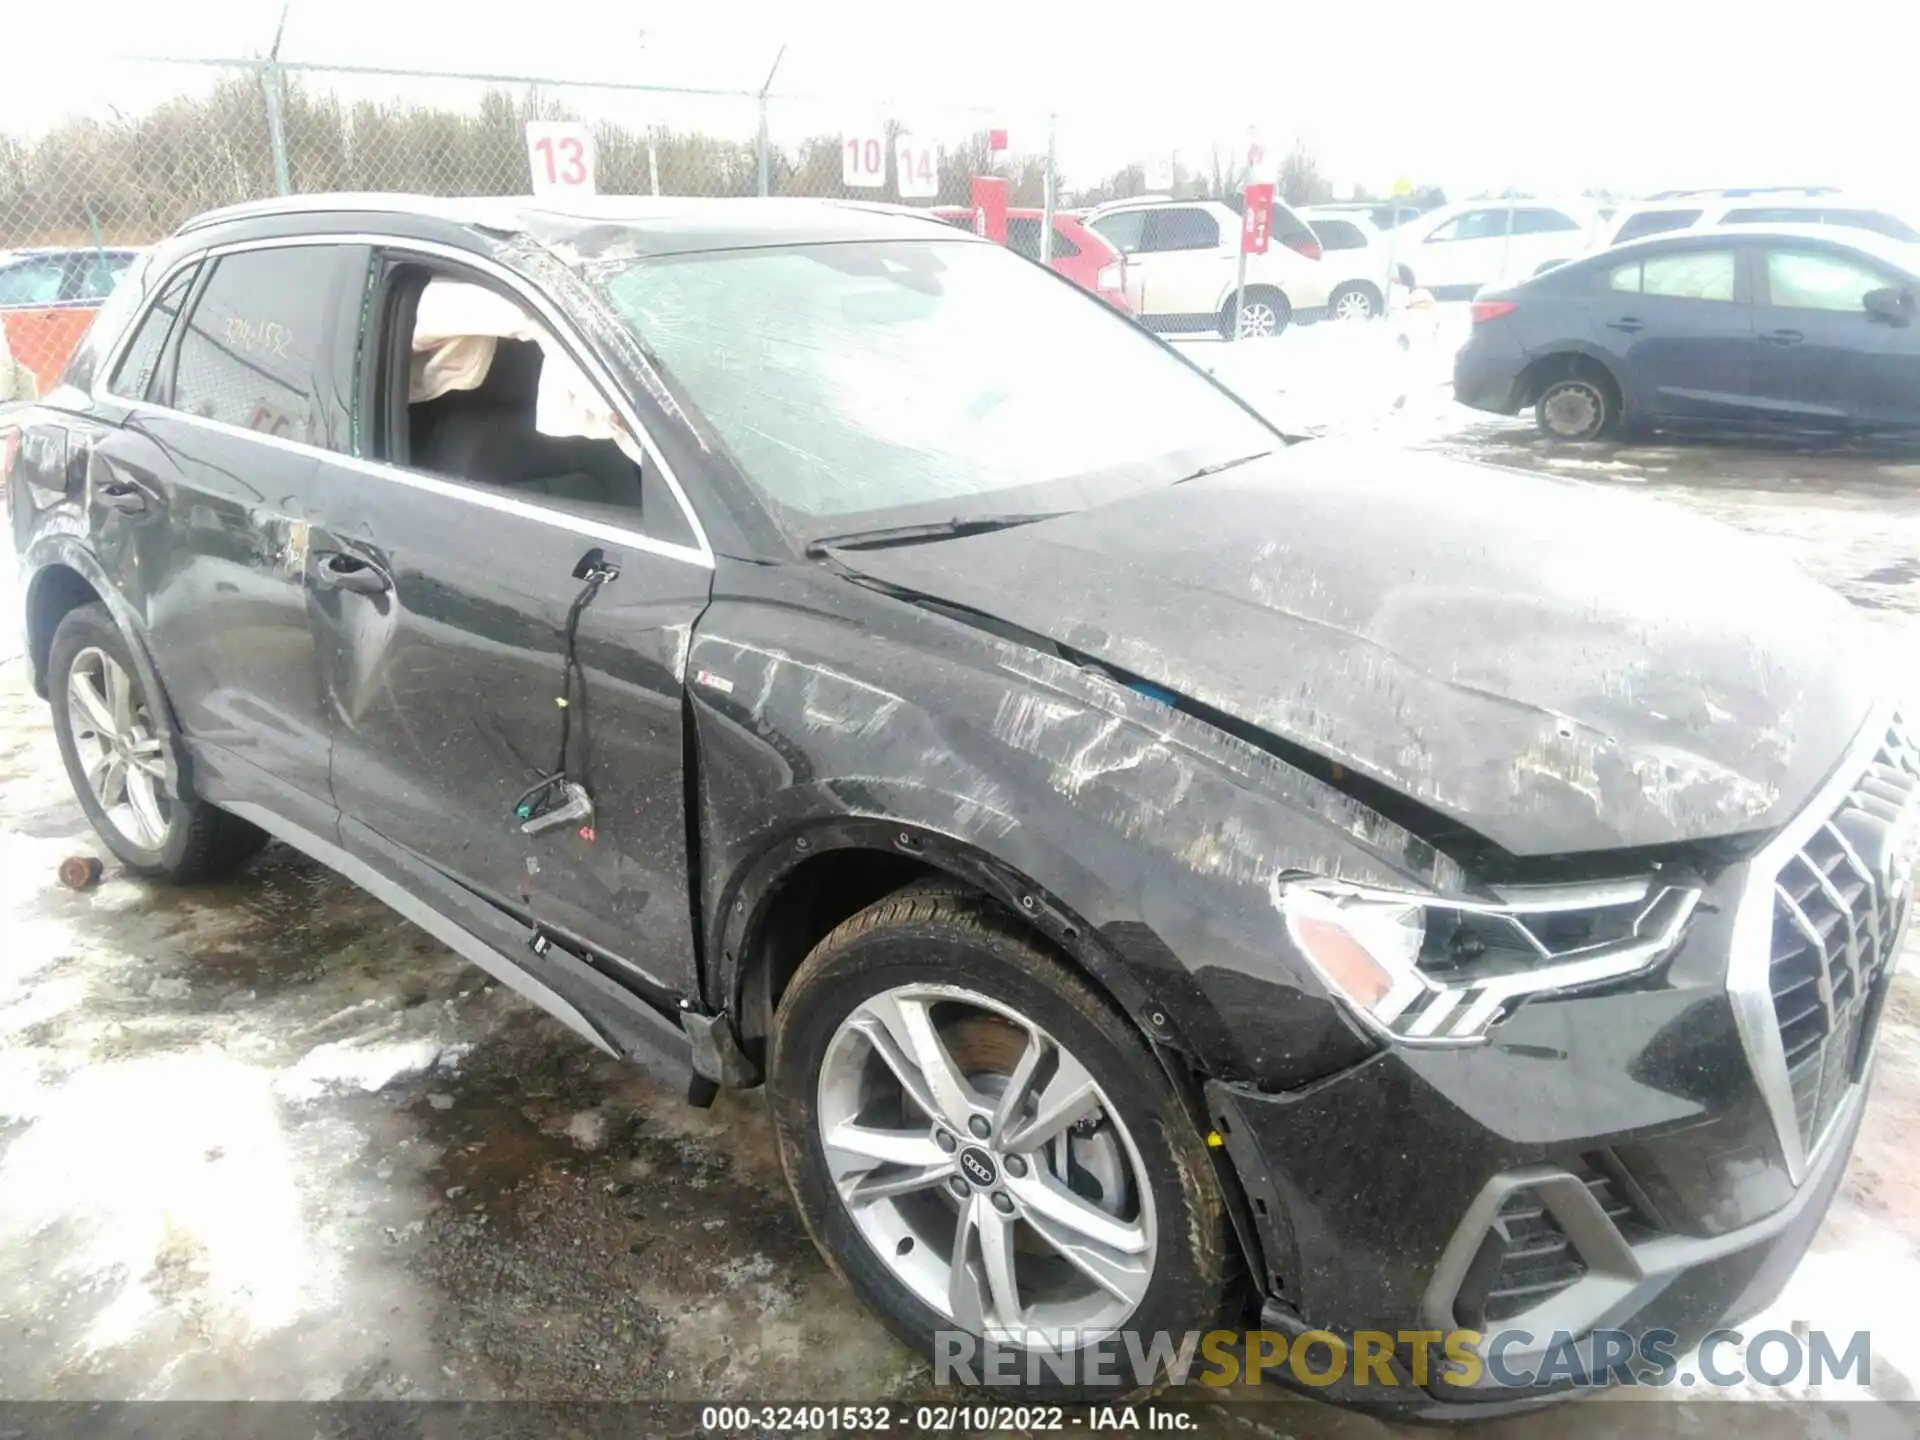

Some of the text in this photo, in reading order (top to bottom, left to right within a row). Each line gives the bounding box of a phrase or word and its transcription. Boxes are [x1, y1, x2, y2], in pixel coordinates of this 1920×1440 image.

[535, 136, 588, 185] 13
[847, 138, 880, 175] 10
[900, 148, 934, 184] 14
